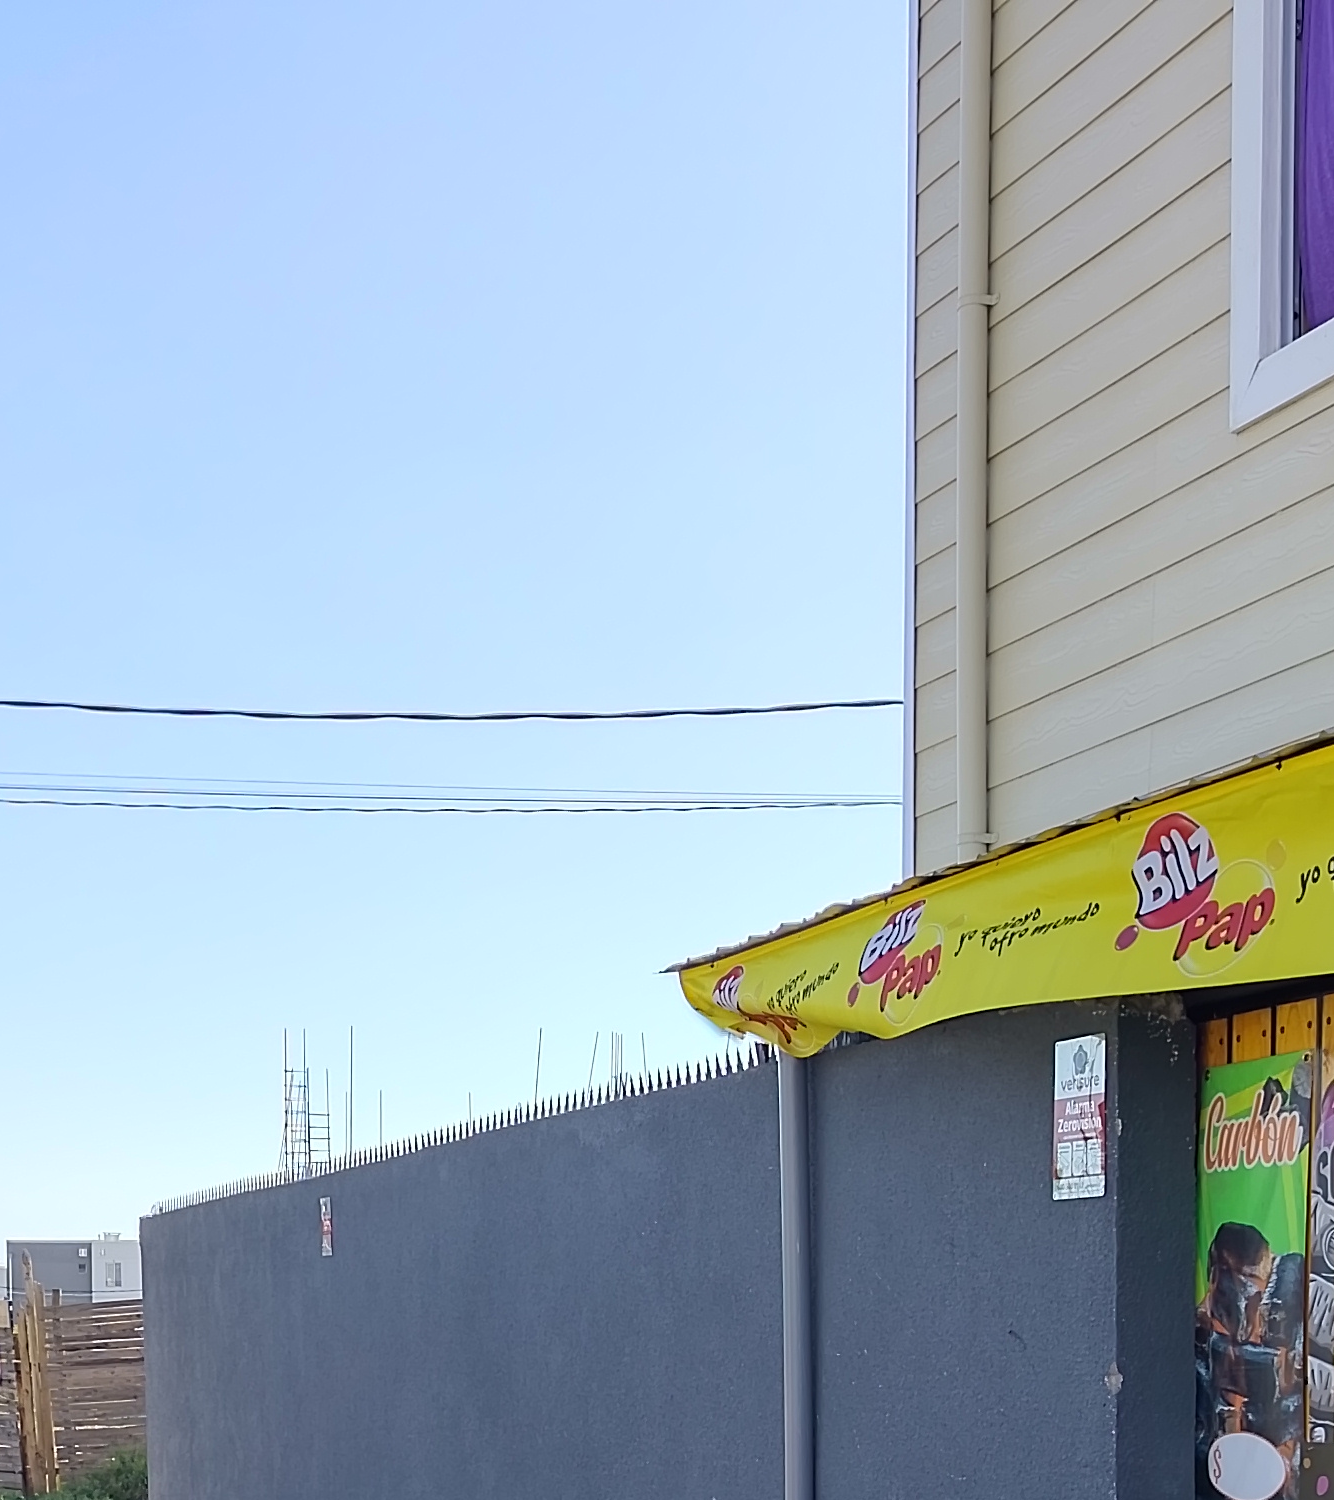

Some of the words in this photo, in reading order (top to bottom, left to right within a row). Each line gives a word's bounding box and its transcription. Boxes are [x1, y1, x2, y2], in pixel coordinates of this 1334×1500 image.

[1131, 824, 1220, 919] Bilz
[1296, 865, 1321, 904] yo
[858, 904, 925, 977] Bilz
[954, 929, 976, 958] yo
[981, 907, 1041, 949] quiero
[989, 924, 1025, 957] otro
[1030, 901, 1100, 937] mundo
[1172, 887, 1276, 961] Pap
[880, 944, 941, 1013] Pap
[1065, 1100, 1095, 1116] Alarma
[1204, 1089, 1303, 1173] Carbón
